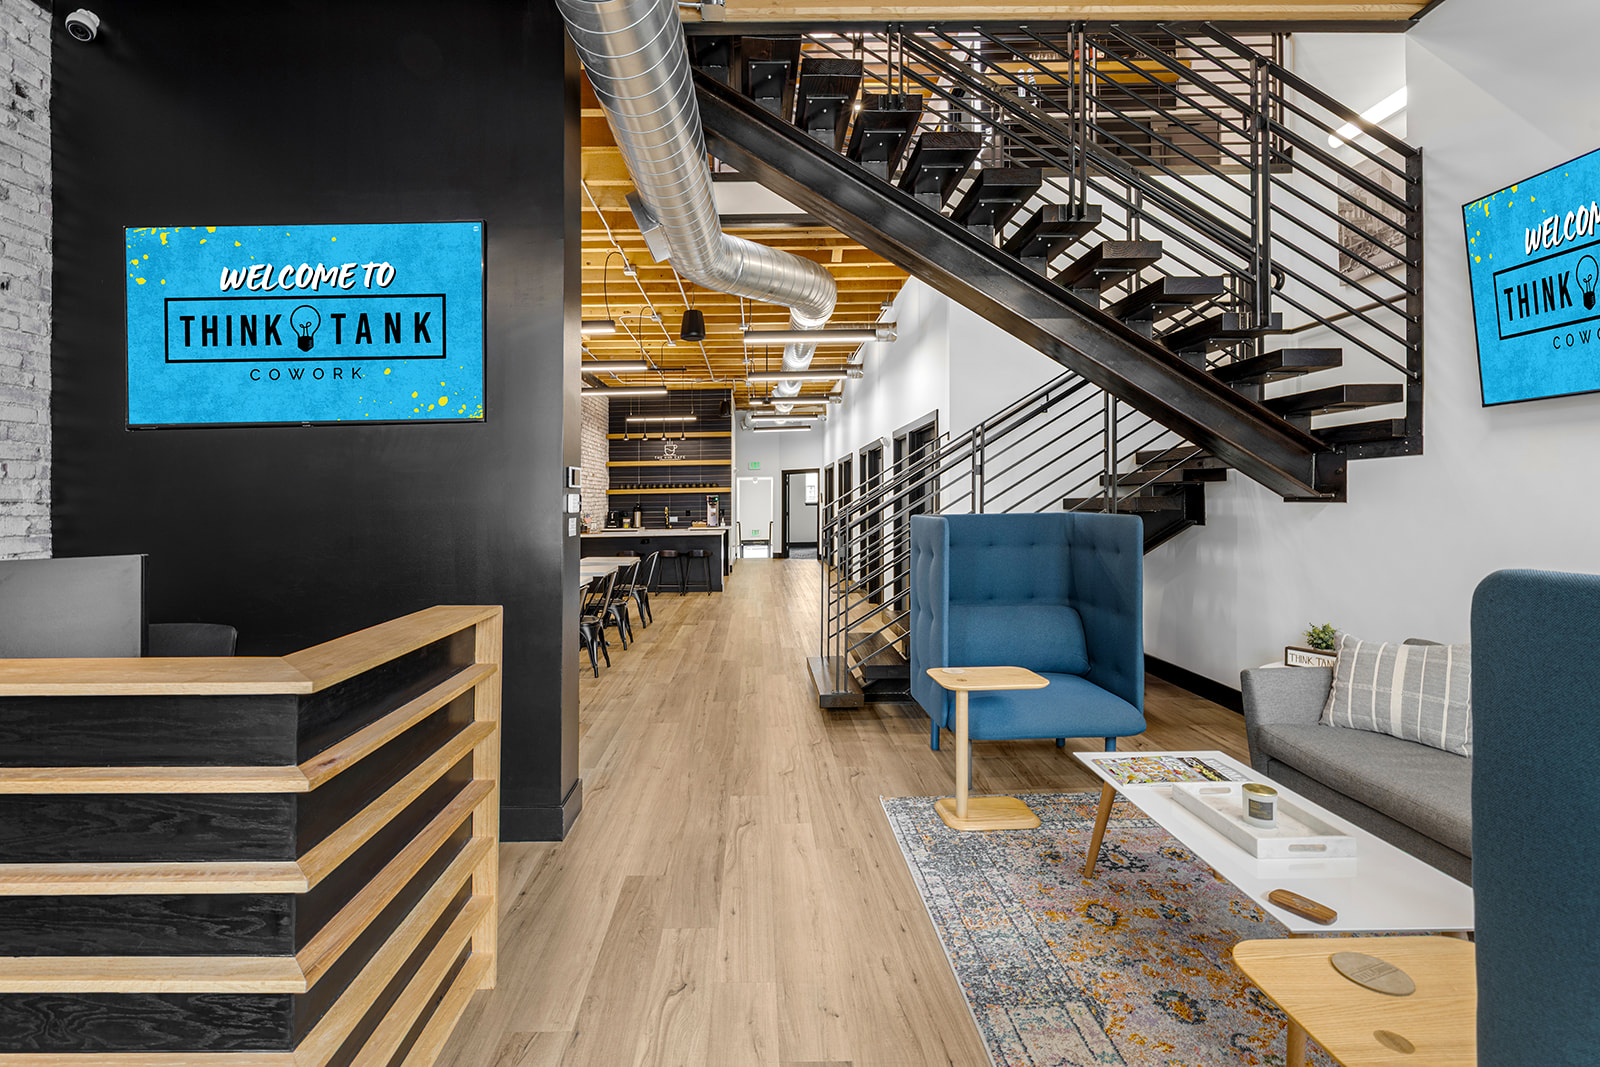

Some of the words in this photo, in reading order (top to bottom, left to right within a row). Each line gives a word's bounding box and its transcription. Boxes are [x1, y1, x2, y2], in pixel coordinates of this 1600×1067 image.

[220, 262, 356, 292] WELCOME
[361, 261, 396, 288] TO
[1503, 270, 1573, 321] THINK
[179, 314, 283, 347] THINK
[331, 311, 432, 345] TANK
[250, 367, 362, 381] COWORK
[1289, 652, 1314, 665] THINK
[1315, 657, 1335, 667] TAN
